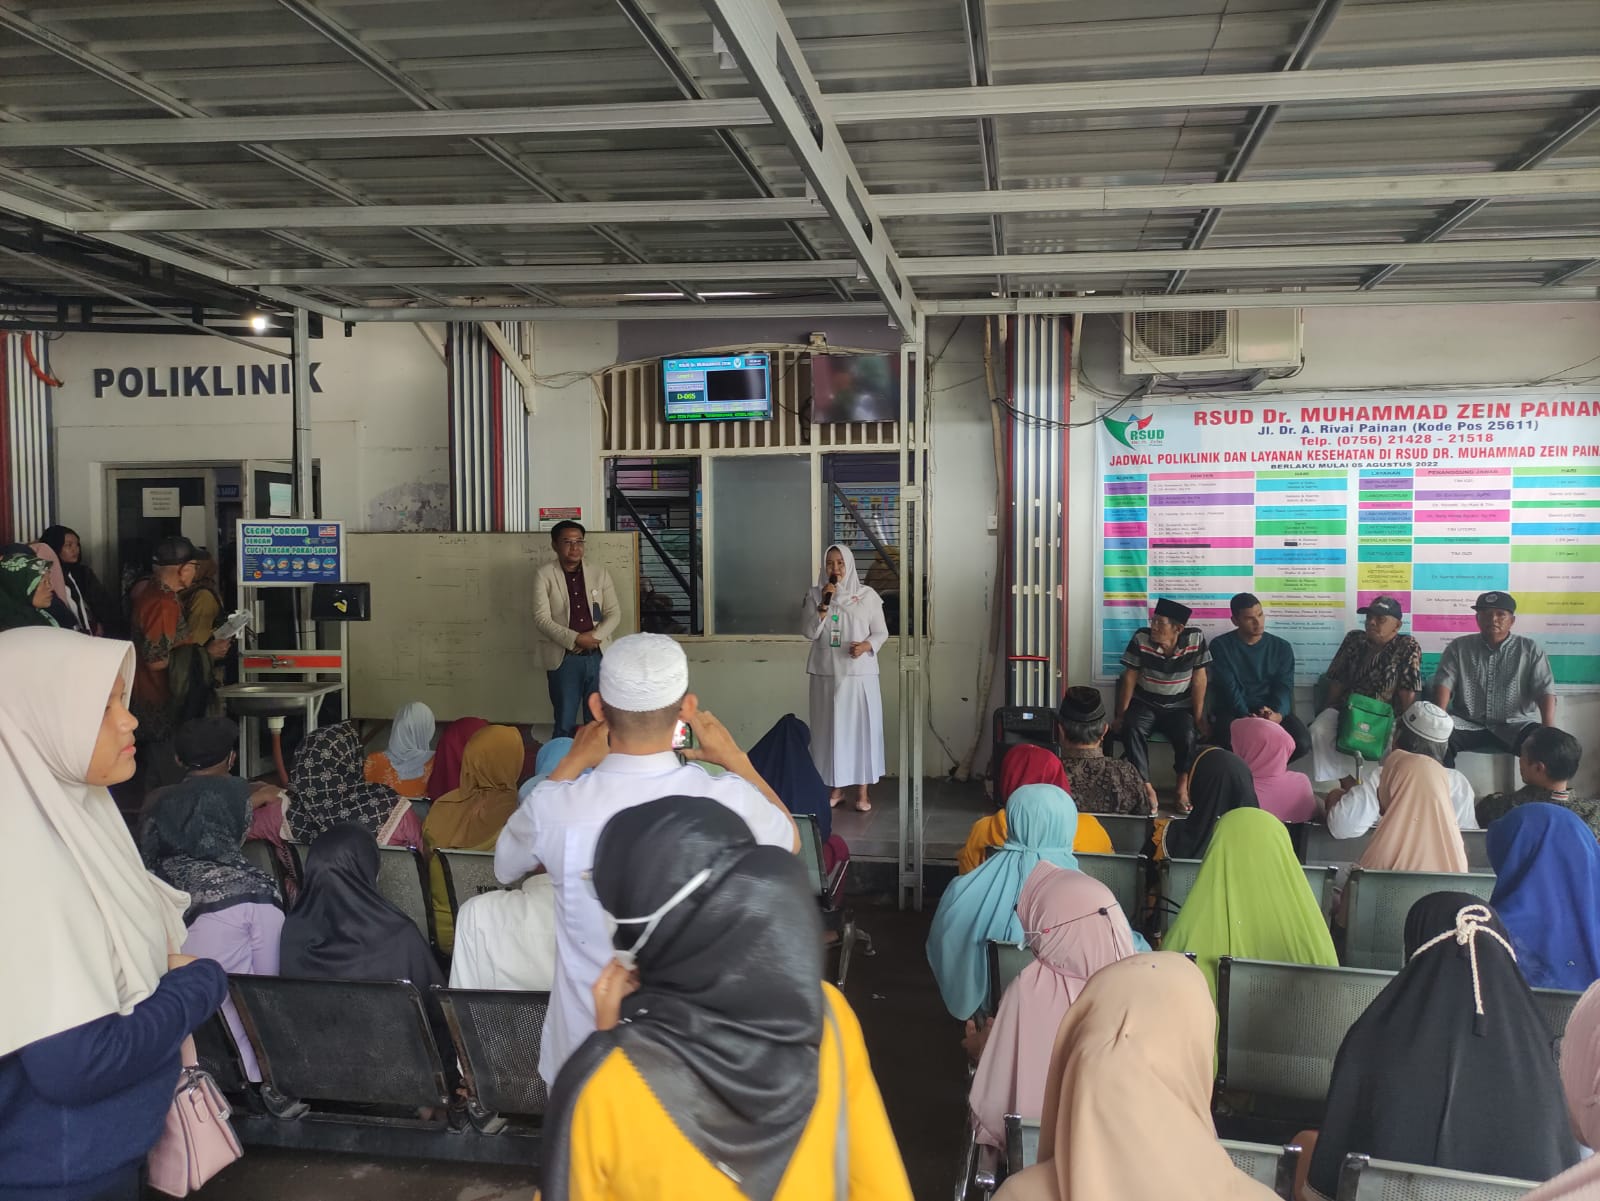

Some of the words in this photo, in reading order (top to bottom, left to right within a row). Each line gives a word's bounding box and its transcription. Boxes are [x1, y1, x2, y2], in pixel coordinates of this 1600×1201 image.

[94, 362, 323, 398] POLIKLINIK
[1194, 409, 1254, 425] RSUD
[1263, 408, 1291, 424] Dr.
[1301, 404, 1447, 423] MUHAMMAD
[1457, 402, 1511, 419] ZEIN
[1130, 429, 1164, 441] RSUD
[1258, 426, 1274, 436] Jl.
[1279, 425, 1297, 435] Dr.
[1301, 424, 1315, 435] A.
[1320, 423, 1354, 434] Rivai
[1359, 423, 1407, 433] Painan
[1412, 421, 1452, 433] (Kode
[1457, 421, 1482, 431] Pos
[1487, 420, 1539, 431] 25611)
[1300, 436, 1332, 448] Telp.
[1337, 435, 1382, 446] (0756)
[1388, 434, 1432, 444] 21428
[1448, 433, 1494, 444] 21518
[1109, 454, 1153, 466] JADWAL
[1157, 451, 1220, 465] POLIKLINIK
[1224, 451, 1247, 463] DAN
[1251, 450, 1302, 463] LAYANAN
[1307, 448, 1374, 461] KESEHATAN
[1379, 448, 1391, 460] DI
[1395, 447, 1428, 460] RSUD
[1433, 447, 1454, 459] DR.
[1458, 445, 1536, 458] MUHAMMAD
[1540, 446, 1568, 457] ZEIN
[1572, 445, 1600, 457] PAIN
[274, 527, 308, 535] CORONA
